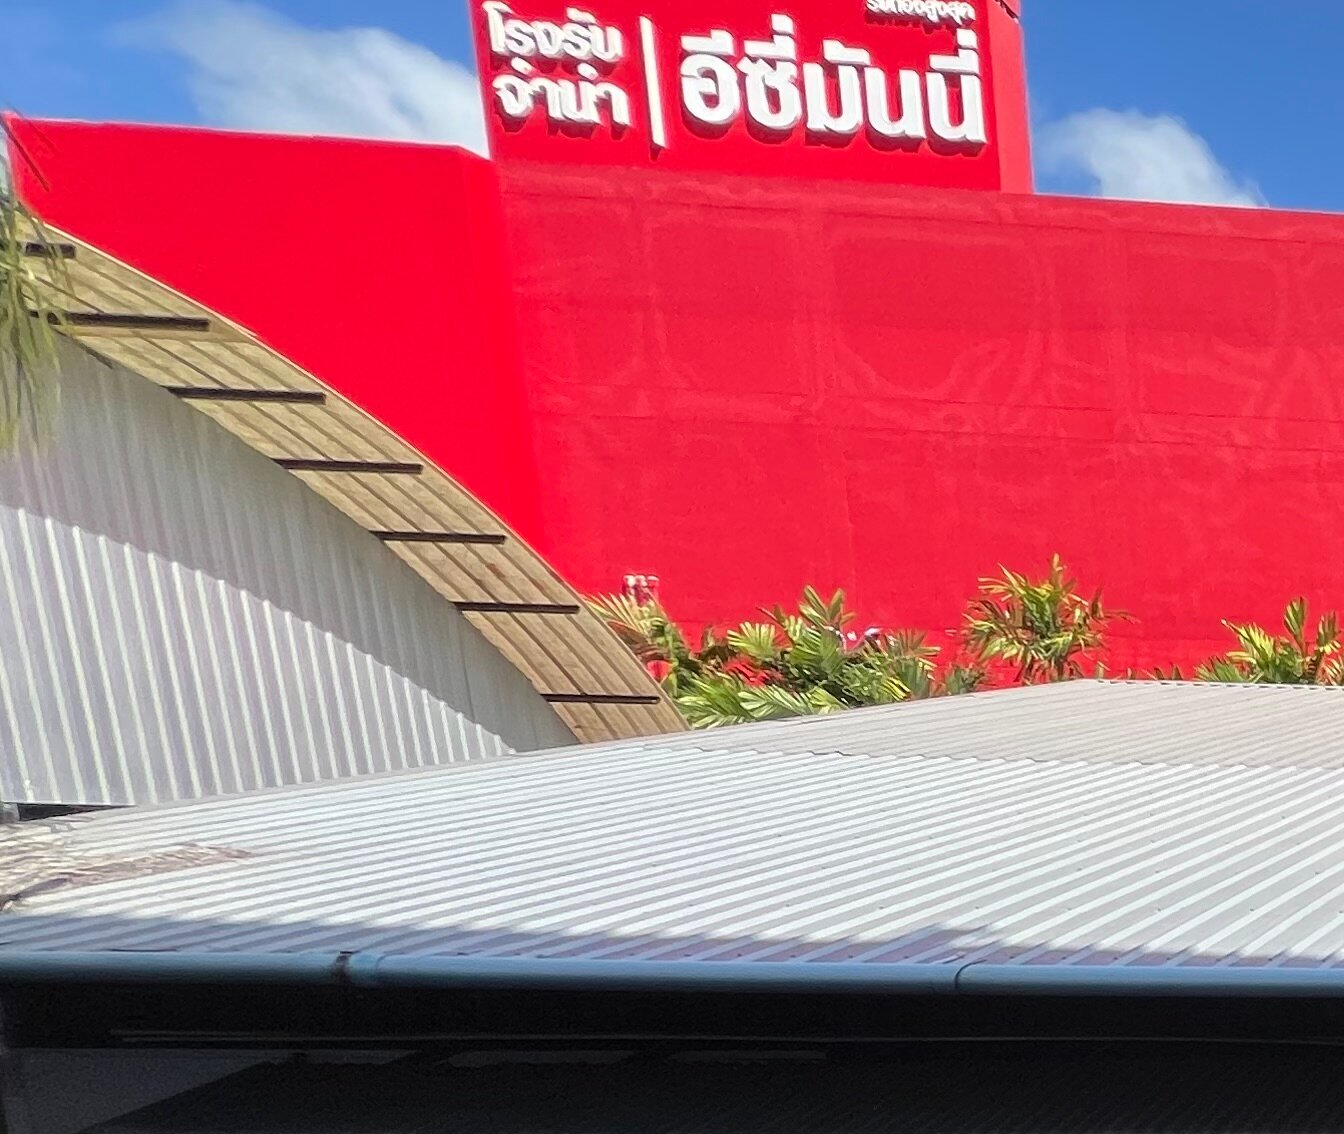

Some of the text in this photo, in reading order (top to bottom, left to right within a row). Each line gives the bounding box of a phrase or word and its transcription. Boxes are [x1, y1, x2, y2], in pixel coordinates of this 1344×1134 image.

[482, 1, 623, 62] โรงรับ
[492, 57, 634, 127] จำนำ
[680, 13, 987, 143] อีซี่มันนี่
